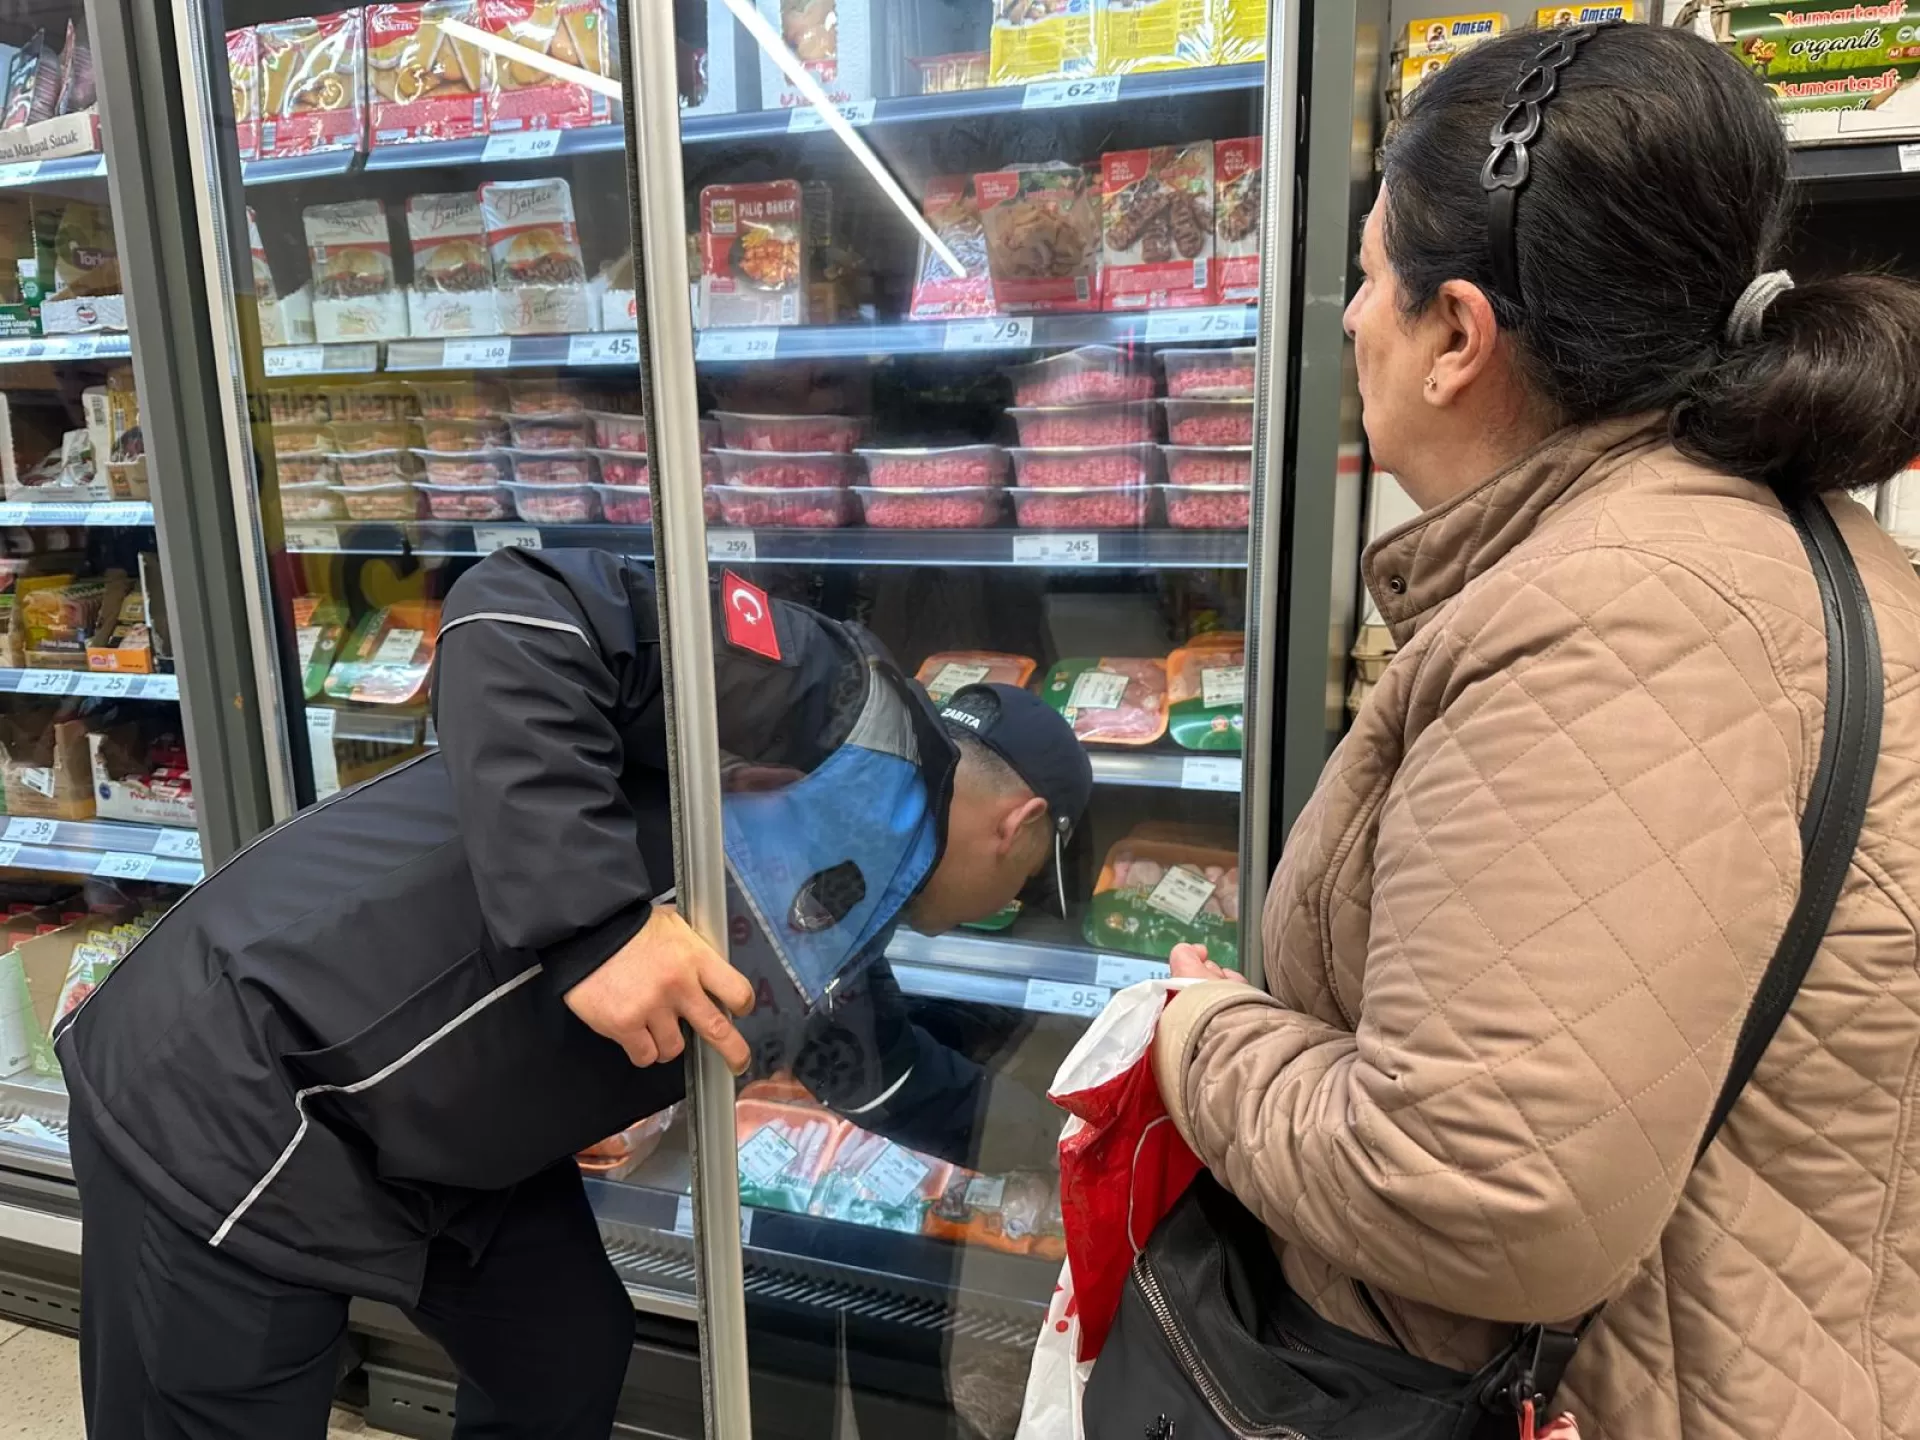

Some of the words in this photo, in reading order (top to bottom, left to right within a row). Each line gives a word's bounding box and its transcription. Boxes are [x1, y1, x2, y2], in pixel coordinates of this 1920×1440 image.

[1580, 7, 1623, 23] OMEGA
[1451, 20, 1493, 37] OMEGA
[1789, 28, 1883, 62] organik
[1066, 83, 1095, 98] 62
[14, 138, 48, 158] Mangal
[49, 130, 78, 149] Sucuk
[1199, 314, 1229, 331] 75
[993, 321, 1020, 340] 79
[485, 347, 504, 358] 160
[608, 338, 631, 355] 45
[516, 537, 536, 548] 235
[726, 540, 747, 552] 259
[1066, 540, 1090, 553] 245
[41, 674, 60, 686] 37
[104, 677, 123, 690] 25
[940, 707, 981, 730] ZABITA
[31, 821, 49, 835] 39
[121, 858, 140, 871] 59
[1071, 990, 1098, 1009] 95
